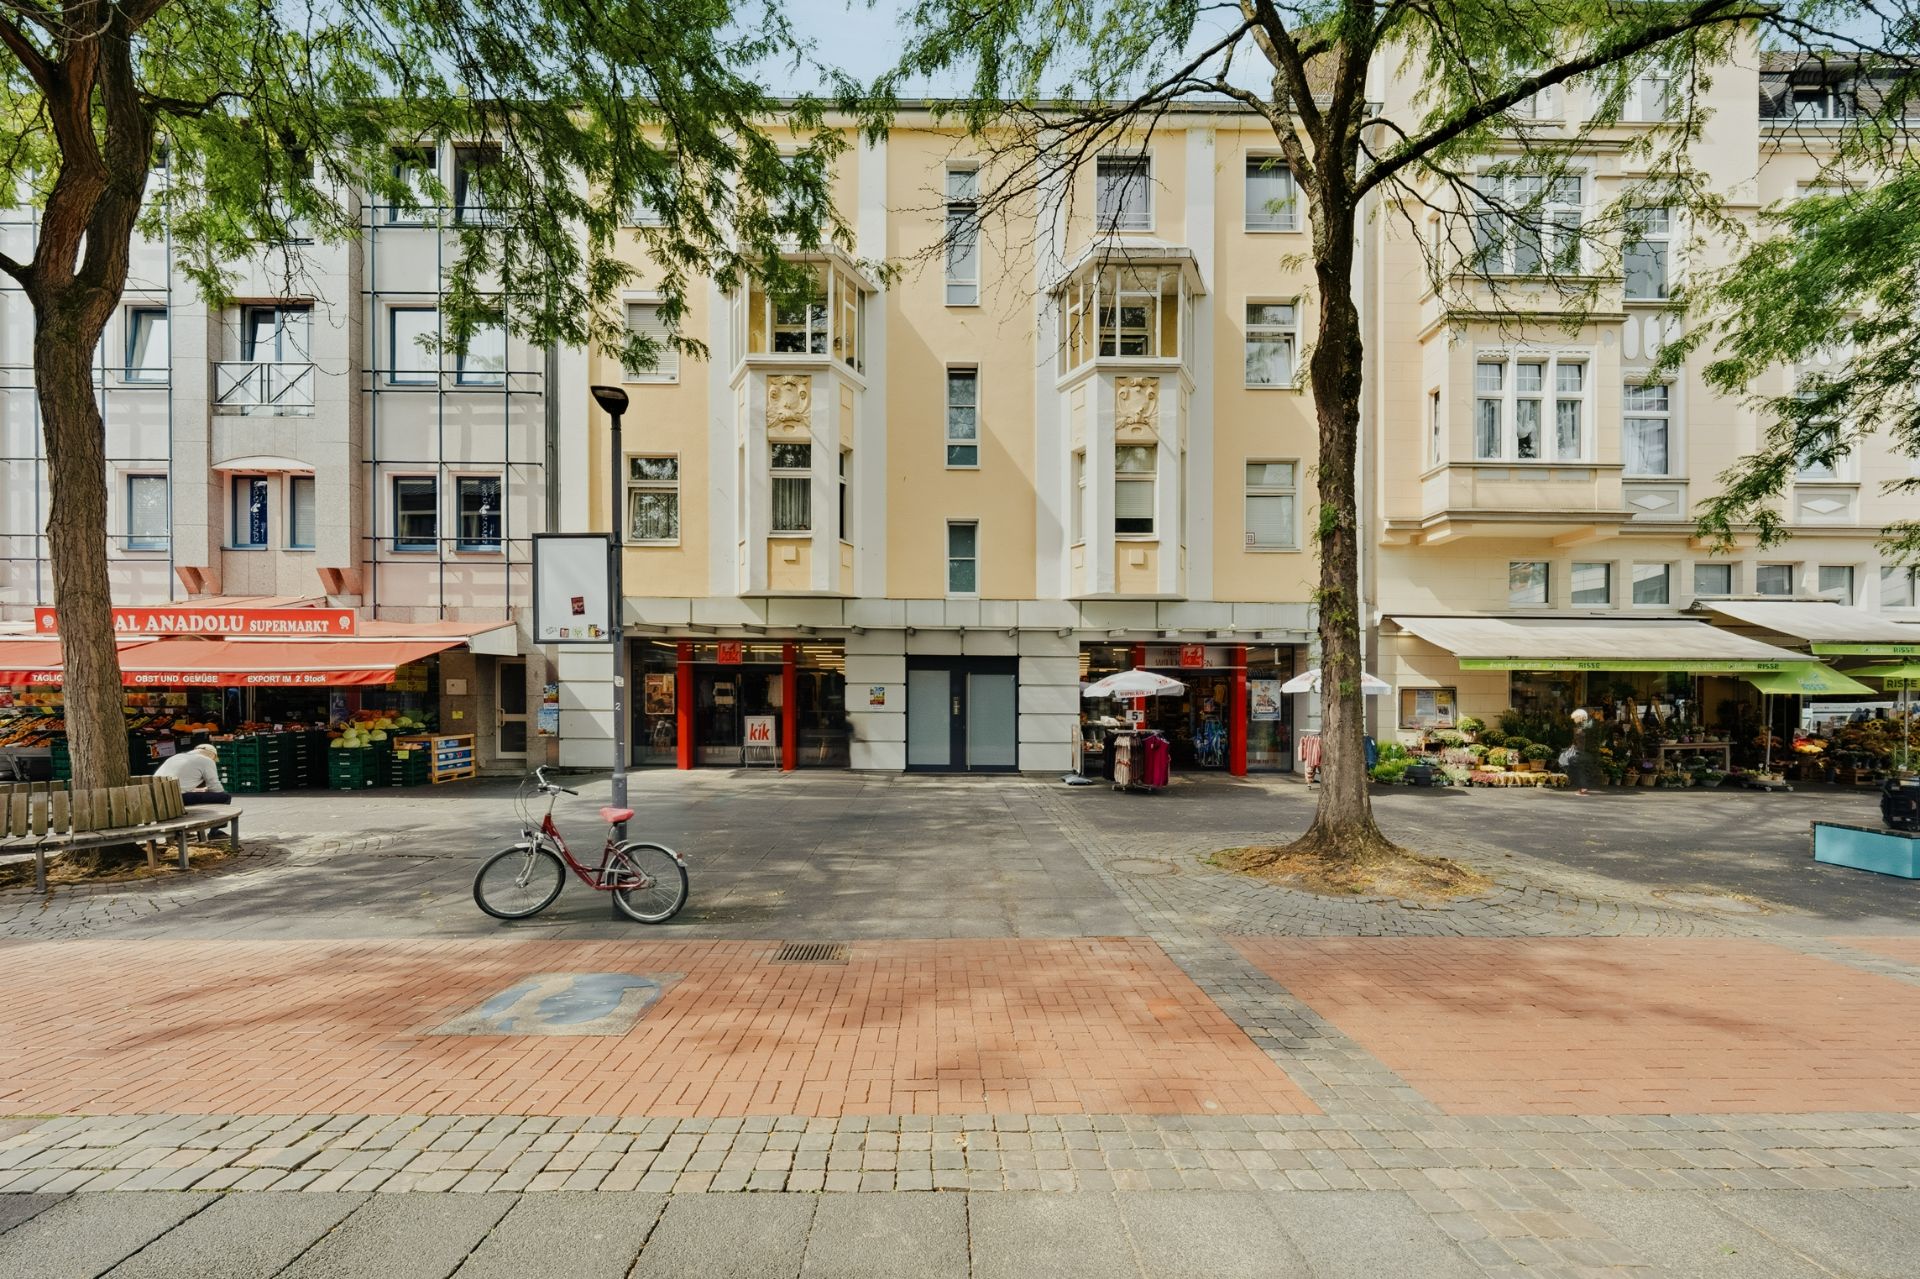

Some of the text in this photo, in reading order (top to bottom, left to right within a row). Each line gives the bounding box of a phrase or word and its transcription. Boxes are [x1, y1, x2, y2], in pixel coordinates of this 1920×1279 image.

[144, 615, 244, 632] ANADOLU
[249, 620, 330, 633] SUPERMARKT
[135, 674, 159, 683] OBST
[161, 674, 179, 683] UND
[182, 673, 218, 683] GEMÜSE
[247, 675, 280, 683] EXPORT
[282, 675, 291, 683] IM
[304, 674, 326, 683] Stock
[1132, 711, 1139, 721] 5
[749, 719, 770, 741] kik
